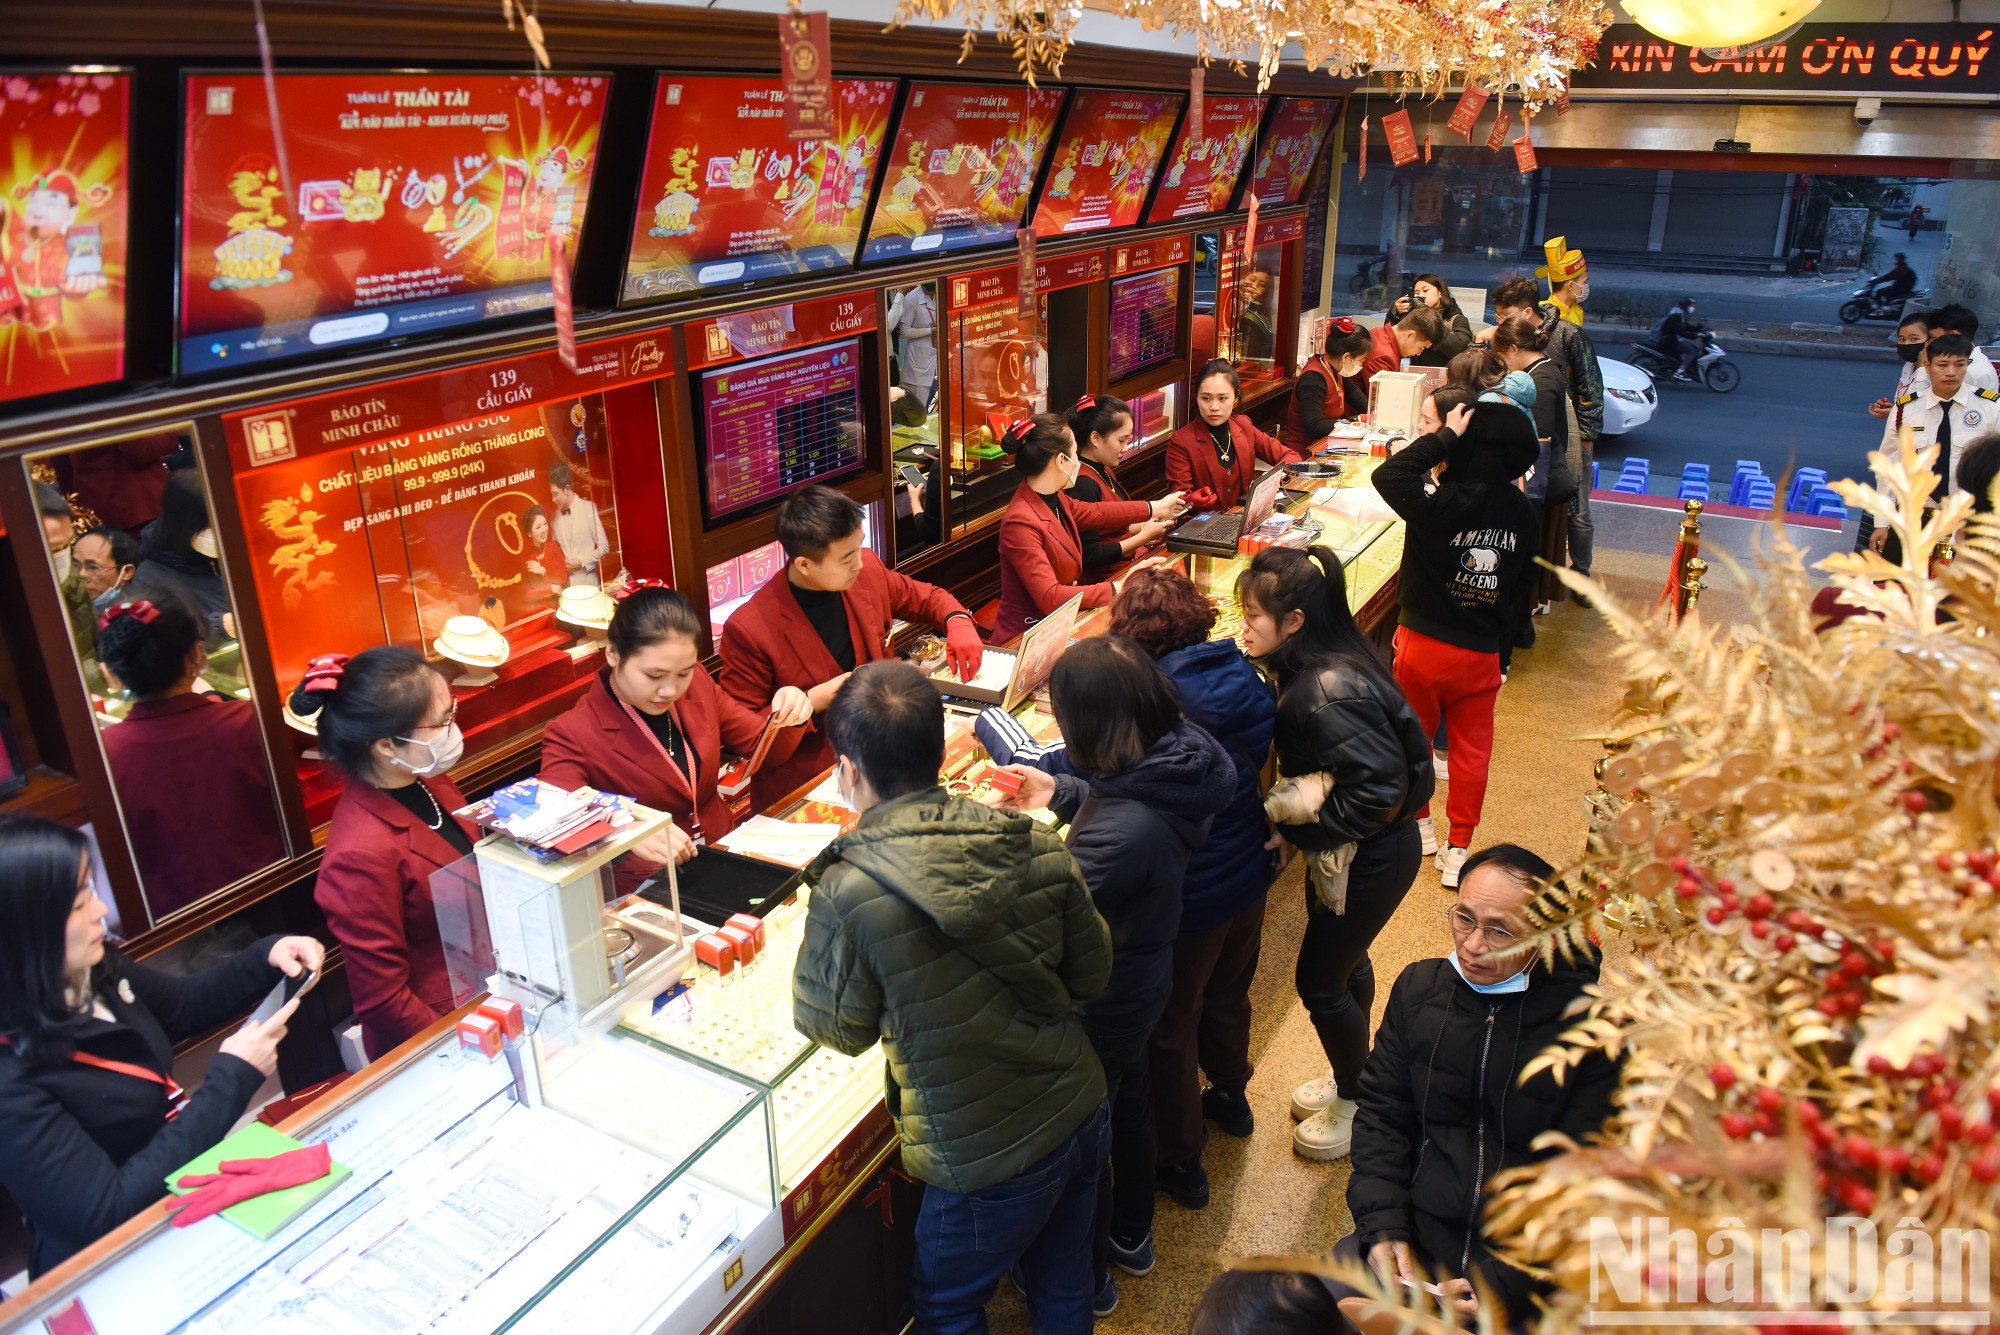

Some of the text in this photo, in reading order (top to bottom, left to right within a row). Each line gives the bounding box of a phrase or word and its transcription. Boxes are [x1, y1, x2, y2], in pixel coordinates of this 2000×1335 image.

[1611, 40, 1674, 72] XIN
[1802, 36, 1875, 75] ƠN
[1890, 30, 1994, 80] QUÝ
[393, 87, 439, 107] THẦN
[443, 88, 470, 107] TÀI
[1034, 266, 1046, 277] 139
[838, 303, 854, 316] 139
[751, 317, 782, 334] BẢO TÍN
[830, 315, 863, 332] CẦU GIẤY
[768, 329, 790, 345] CHÂU
[489, 368, 517, 388] 139
[477, 382, 533, 411] CẦU GIẤY
[331, 398, 388, 423] BẢO TÍN
[321, 414, 400, 444] MINH CHÂU
[318, 469, 353, 493] CHẤT
[383, 456, 418, 476] BẰNG
[418, 449, 451, 469] VÀNG
[452, 441, 482, 461] RỒNG
[482, 432, 518, 452] THĂNG
[518, 425, 545, 444] LONG
[403, 459, 485, 491] 99.9 999.9 (24K)
[343, 516, 364, 532] ĐẸP
[366, 509, 391, 525] SANG
[414, 498, 432, 513] ĐEO
[441, 487, 452, 504] DỄ
[454, 485, 477, 502] DÀNG
[479, 477, 507, 495] THANH
[508, 468, 535, 485] KHOẢN
[1449, 529, 1518, 552] AMERICAN
[1455, 571, 1498, 589] LEGEND
